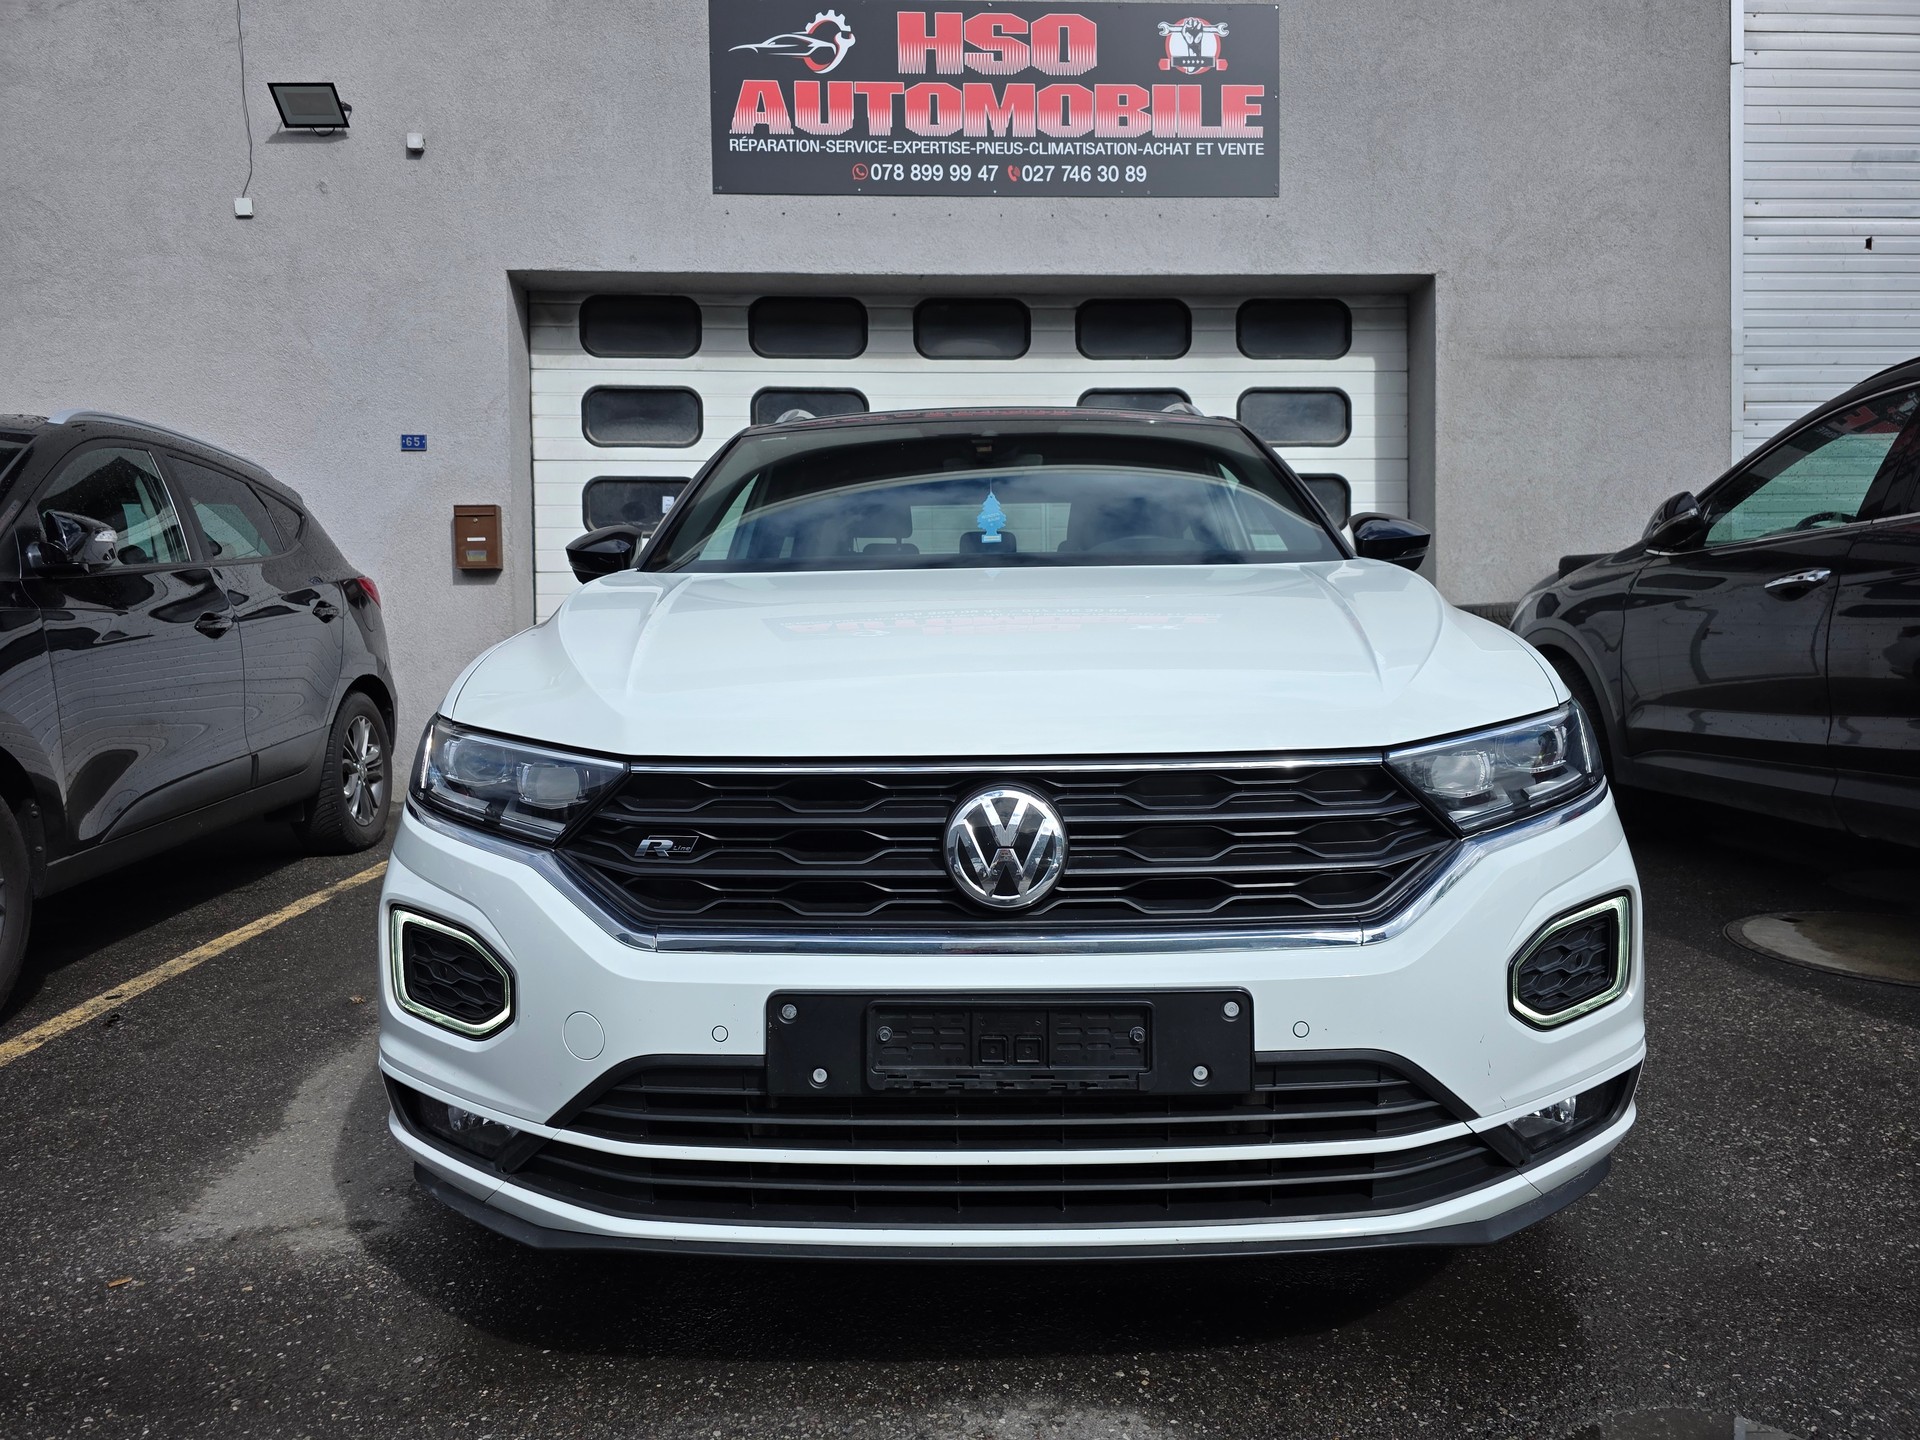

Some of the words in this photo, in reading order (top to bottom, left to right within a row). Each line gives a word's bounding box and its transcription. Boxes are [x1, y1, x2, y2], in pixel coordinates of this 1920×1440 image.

[897, 11, 1098, 76] HSO
[729, 79, 1265, 138] AUTOMOBILE
[1195, 142, 1213, 156] ET
[1217, 142, 1265, 156] VENTE
[870, 163, 905, 181] 078
[910, 164, 944, 182] 899
[949, 164, 972, 182] 99
[977, 164, 999, 182] 47
[1021, 164, 1055, 182] 027
[1061, 165, 1092, 182] 746
[1097, 165, 1119, 182] 30
[1125, 165, 1147, 182] 89
[405, 436, 421, 447] 65
[948, 791, 1063, 905] VW
